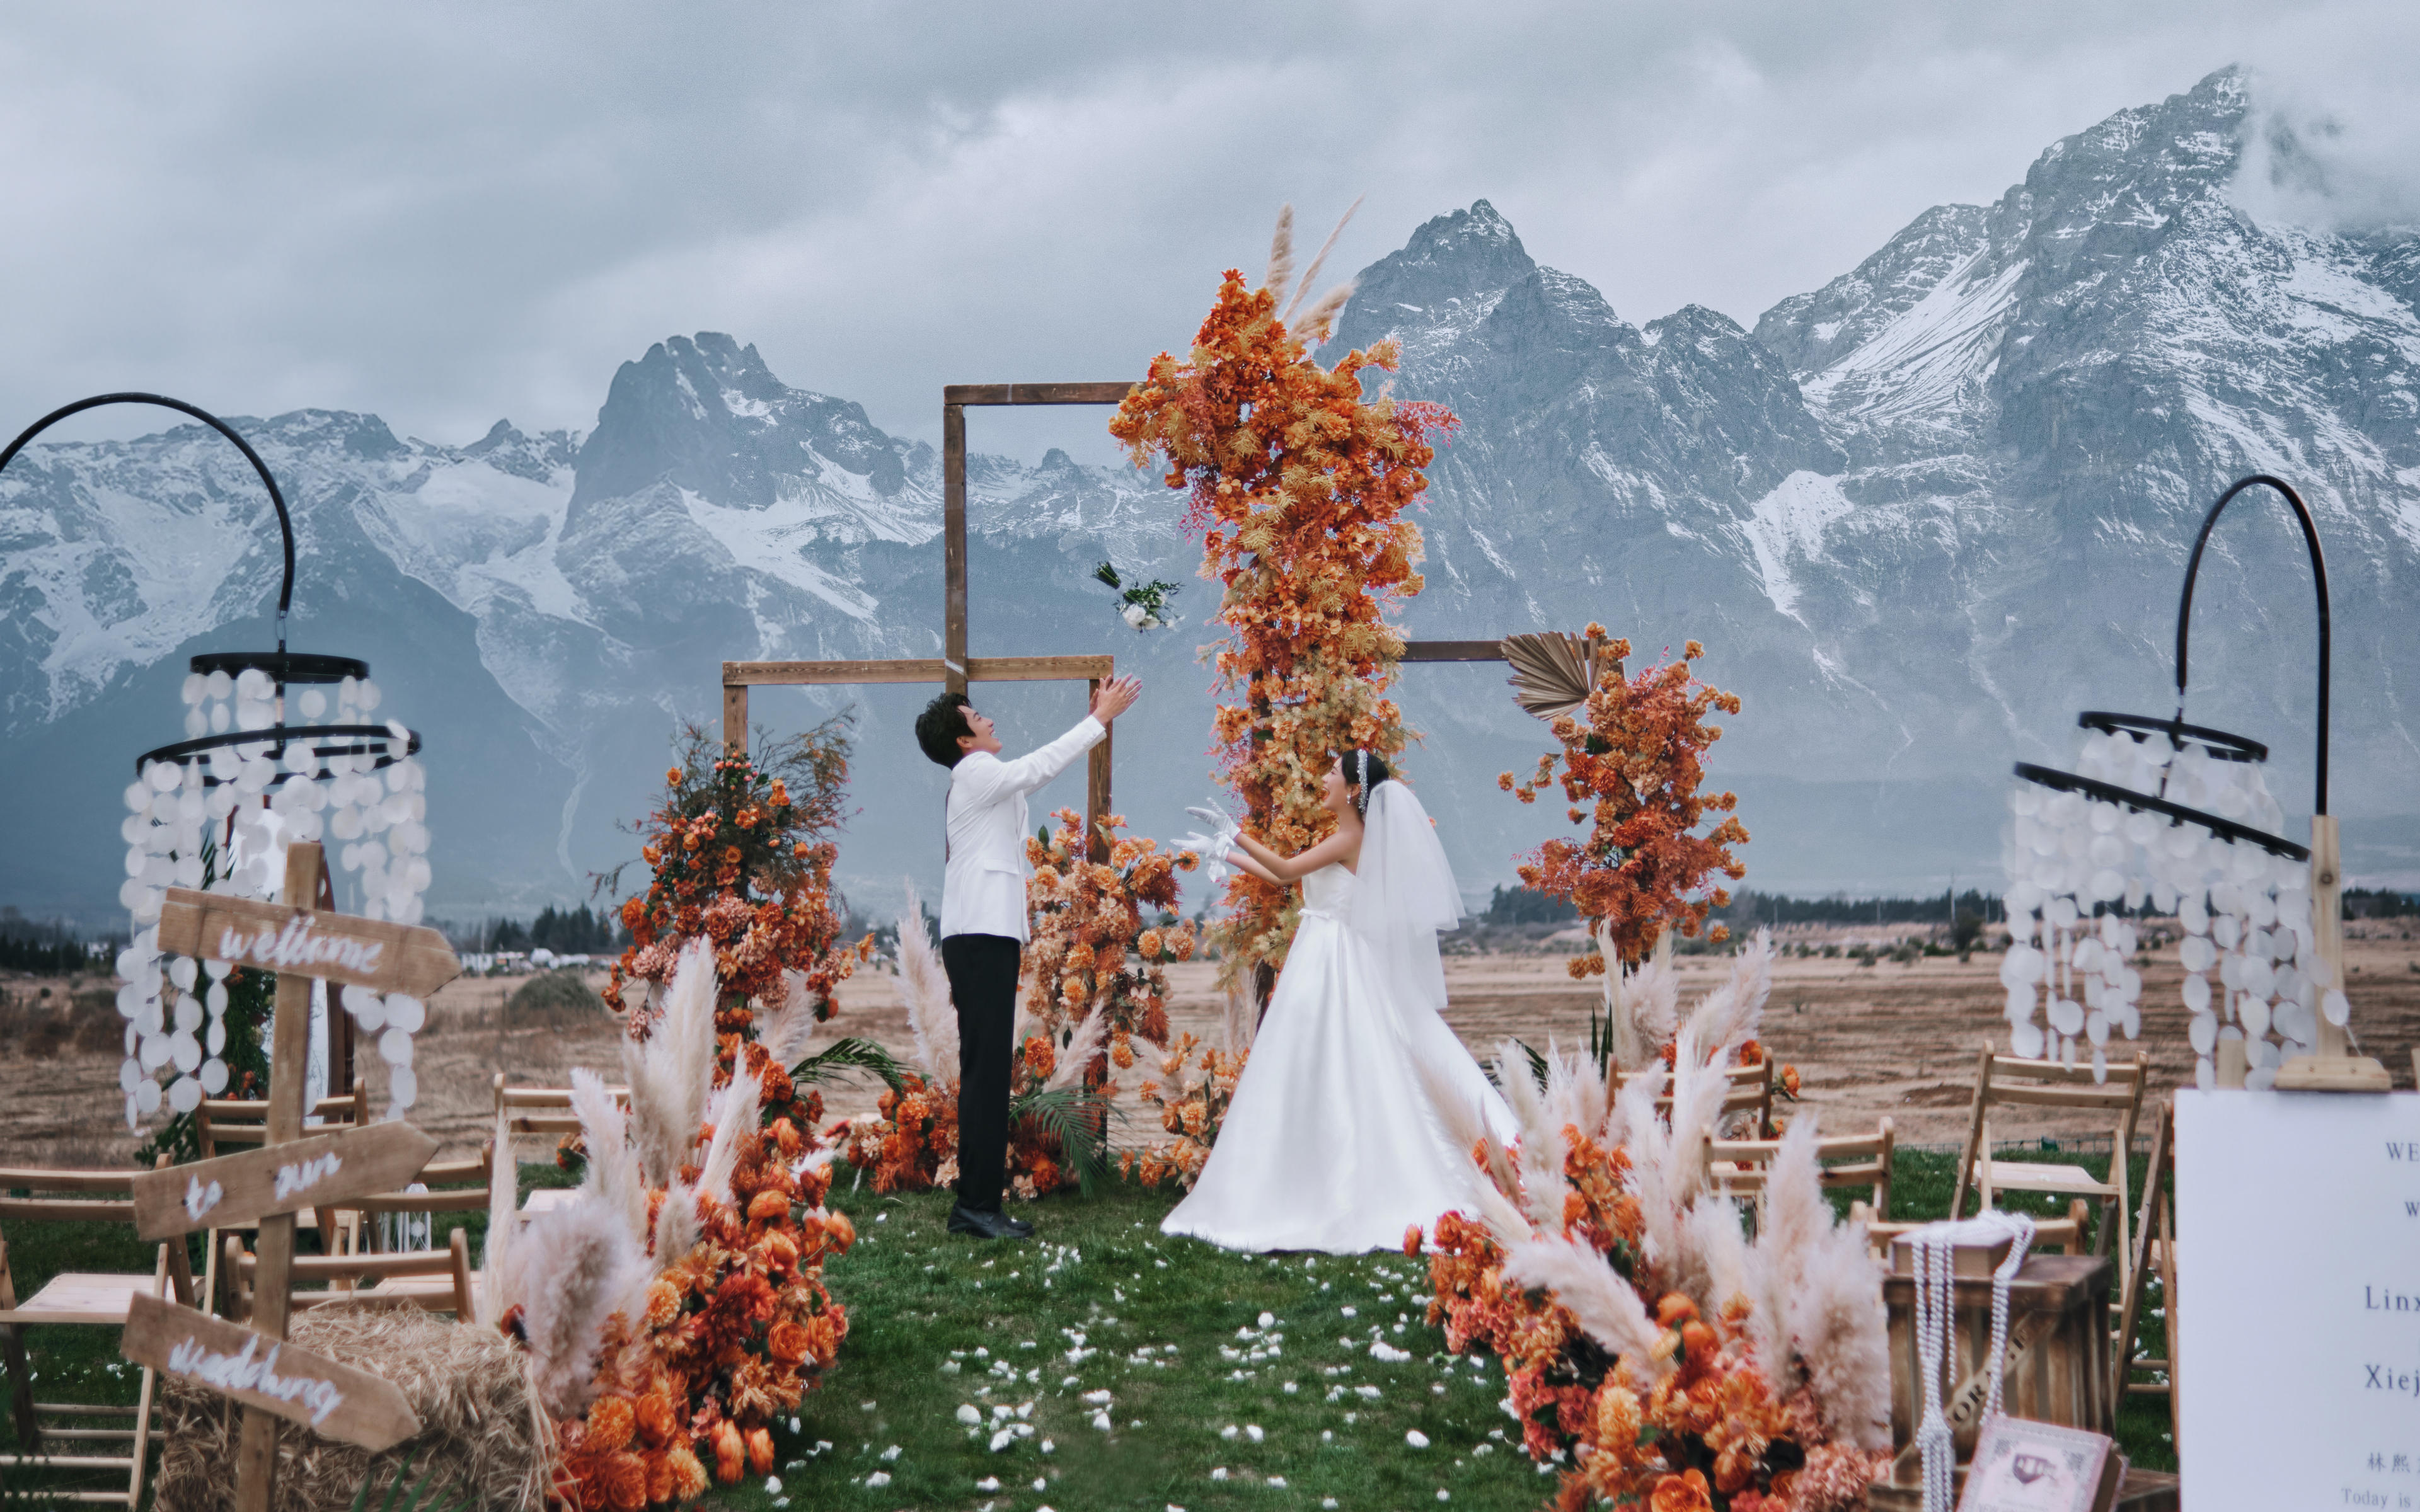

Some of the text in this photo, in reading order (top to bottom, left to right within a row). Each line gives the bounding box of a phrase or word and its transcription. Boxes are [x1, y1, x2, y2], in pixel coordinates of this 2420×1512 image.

[220, 915, 384, 973] welcome
[186, 1173, 223, 1221] to
[2341, 1487, 2411, 1509] Today is
